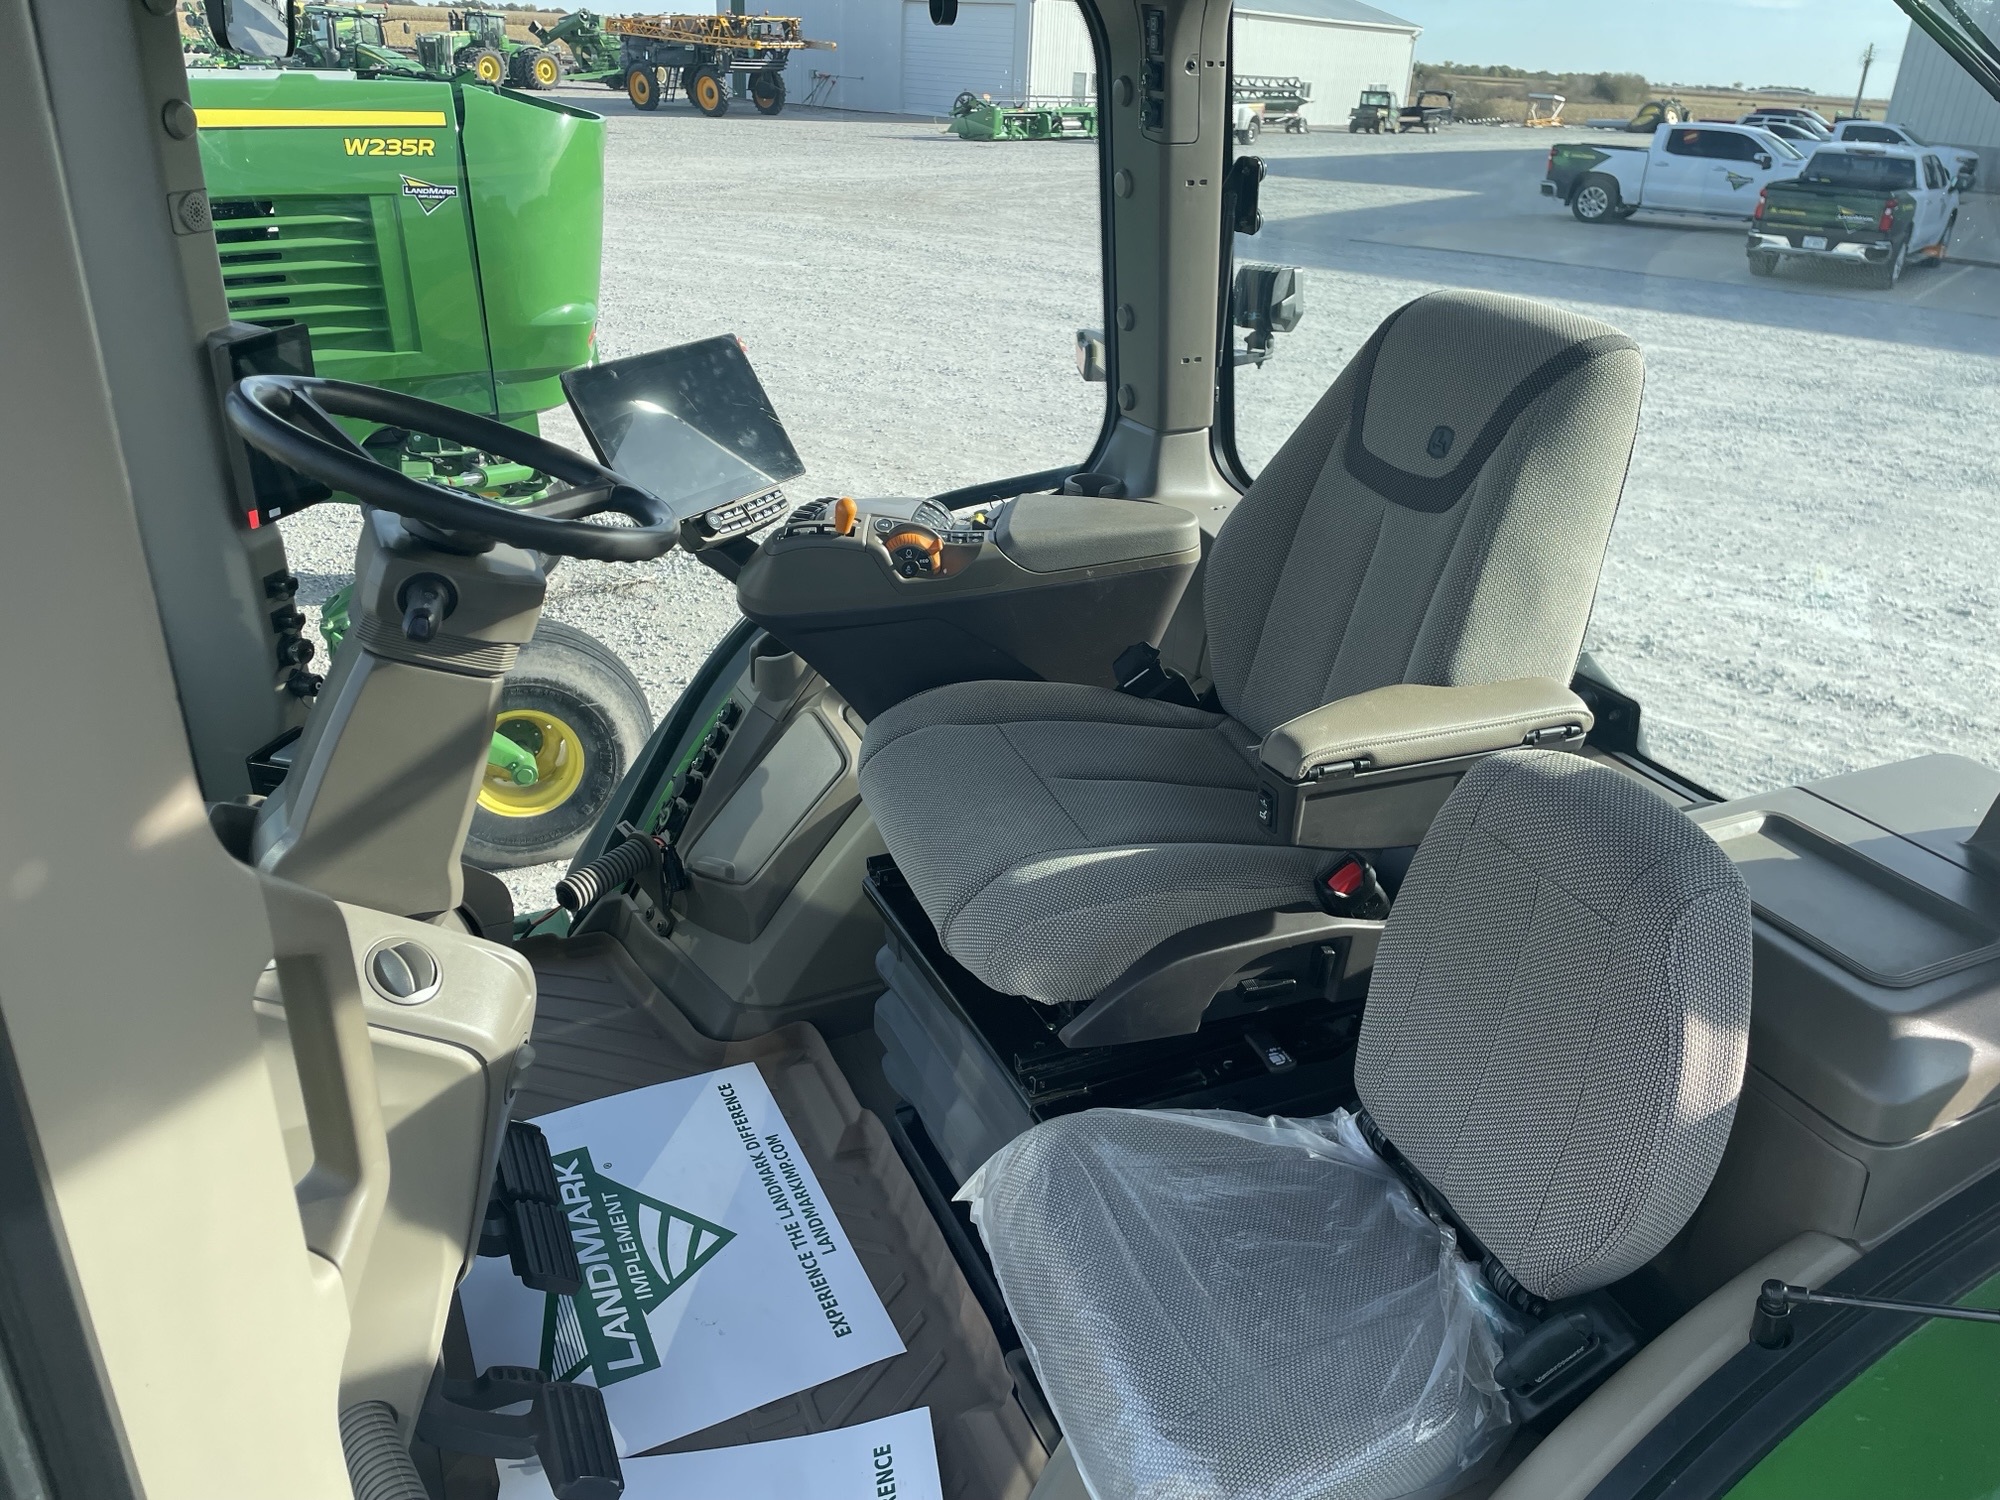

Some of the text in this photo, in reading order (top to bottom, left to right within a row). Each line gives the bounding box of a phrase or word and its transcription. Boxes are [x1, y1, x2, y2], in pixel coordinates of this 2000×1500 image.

[343, 138, 436, 157] W235R
[601, 1192, 654, 1301] IMPLEMENT
[718, 1082, 853, 1338] EXPERIENCE THE LANDMARK DIFFERENCE
[765, 1133, 837, 1255] LANDMARKIMP.COM
[552, 1157, 645, 1371] LANDMARK
